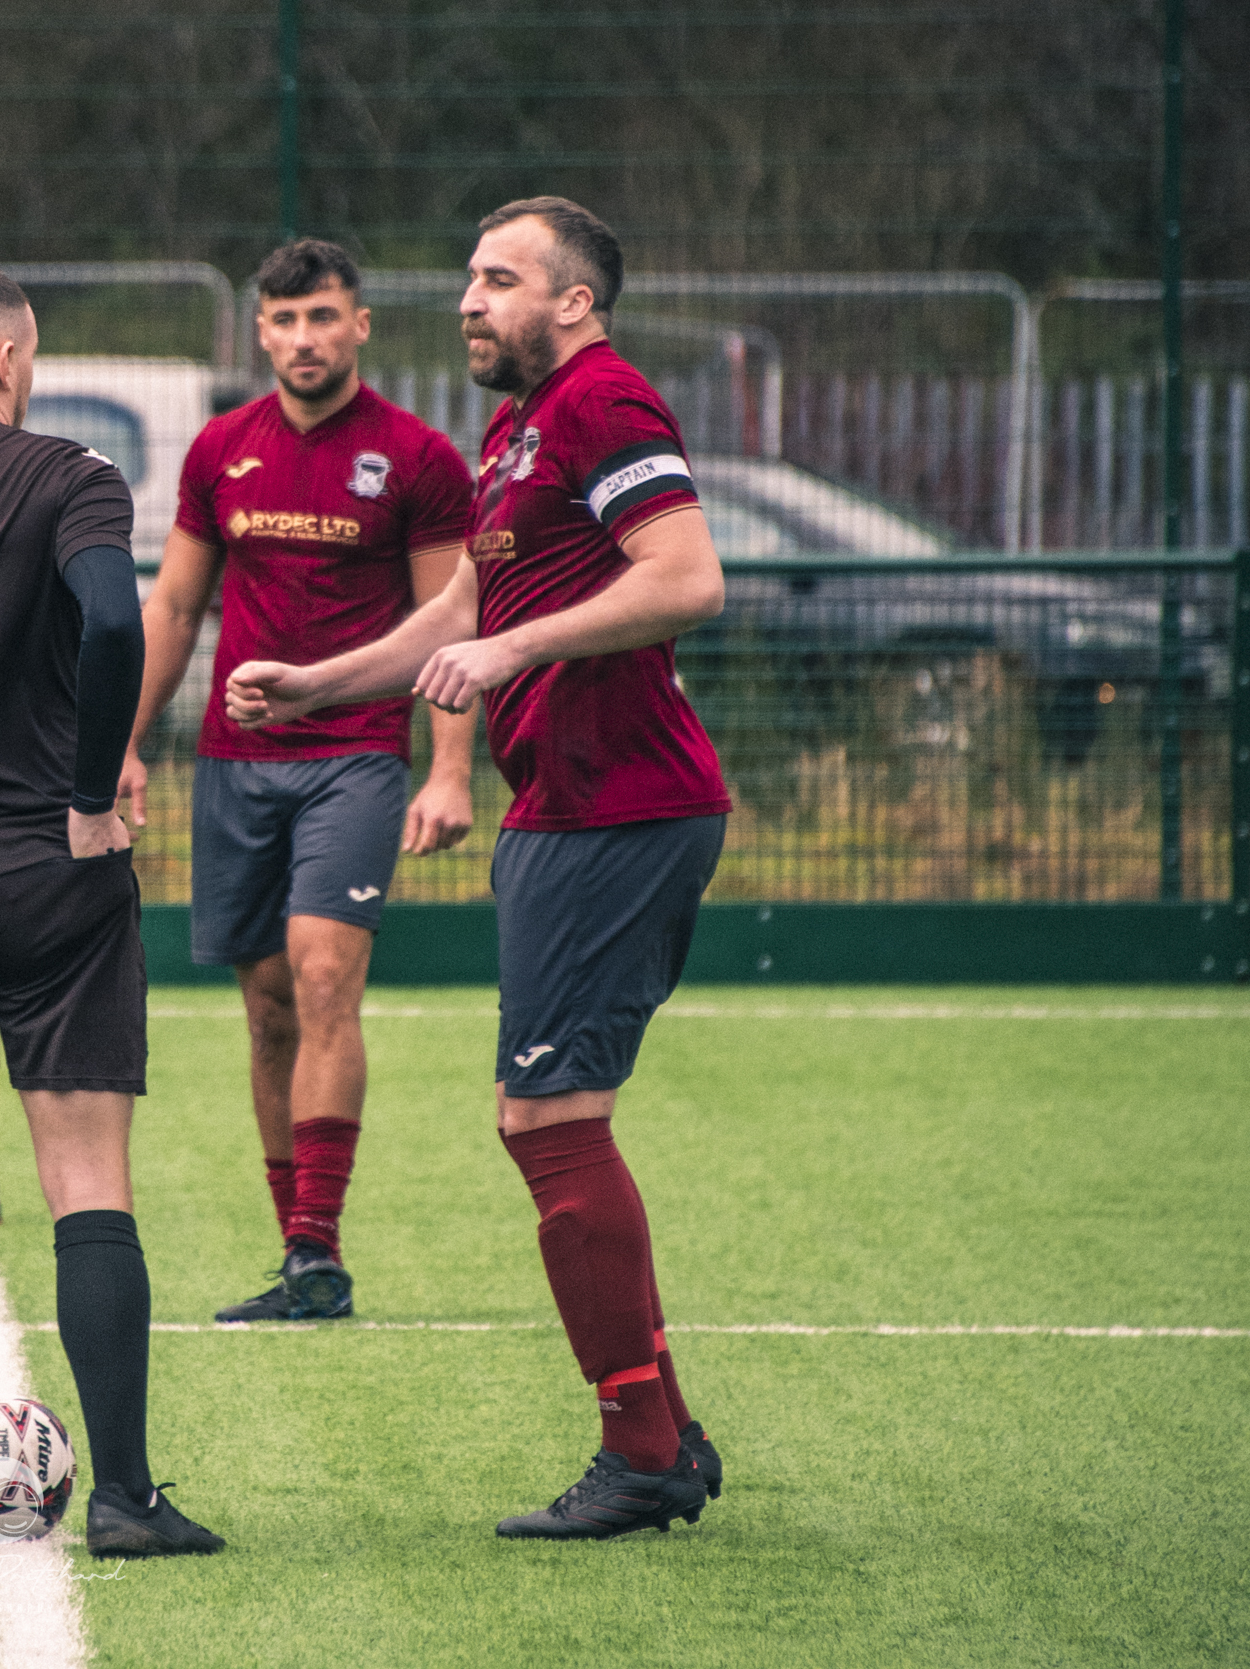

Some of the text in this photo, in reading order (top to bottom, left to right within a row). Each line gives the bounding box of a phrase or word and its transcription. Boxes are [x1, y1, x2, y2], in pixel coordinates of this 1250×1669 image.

[606, 462, 656, 495] CAPTAIN
[251, 511, 361, 537] RYDEC LTD
[34, 1419, 51, 1483] Mitre
